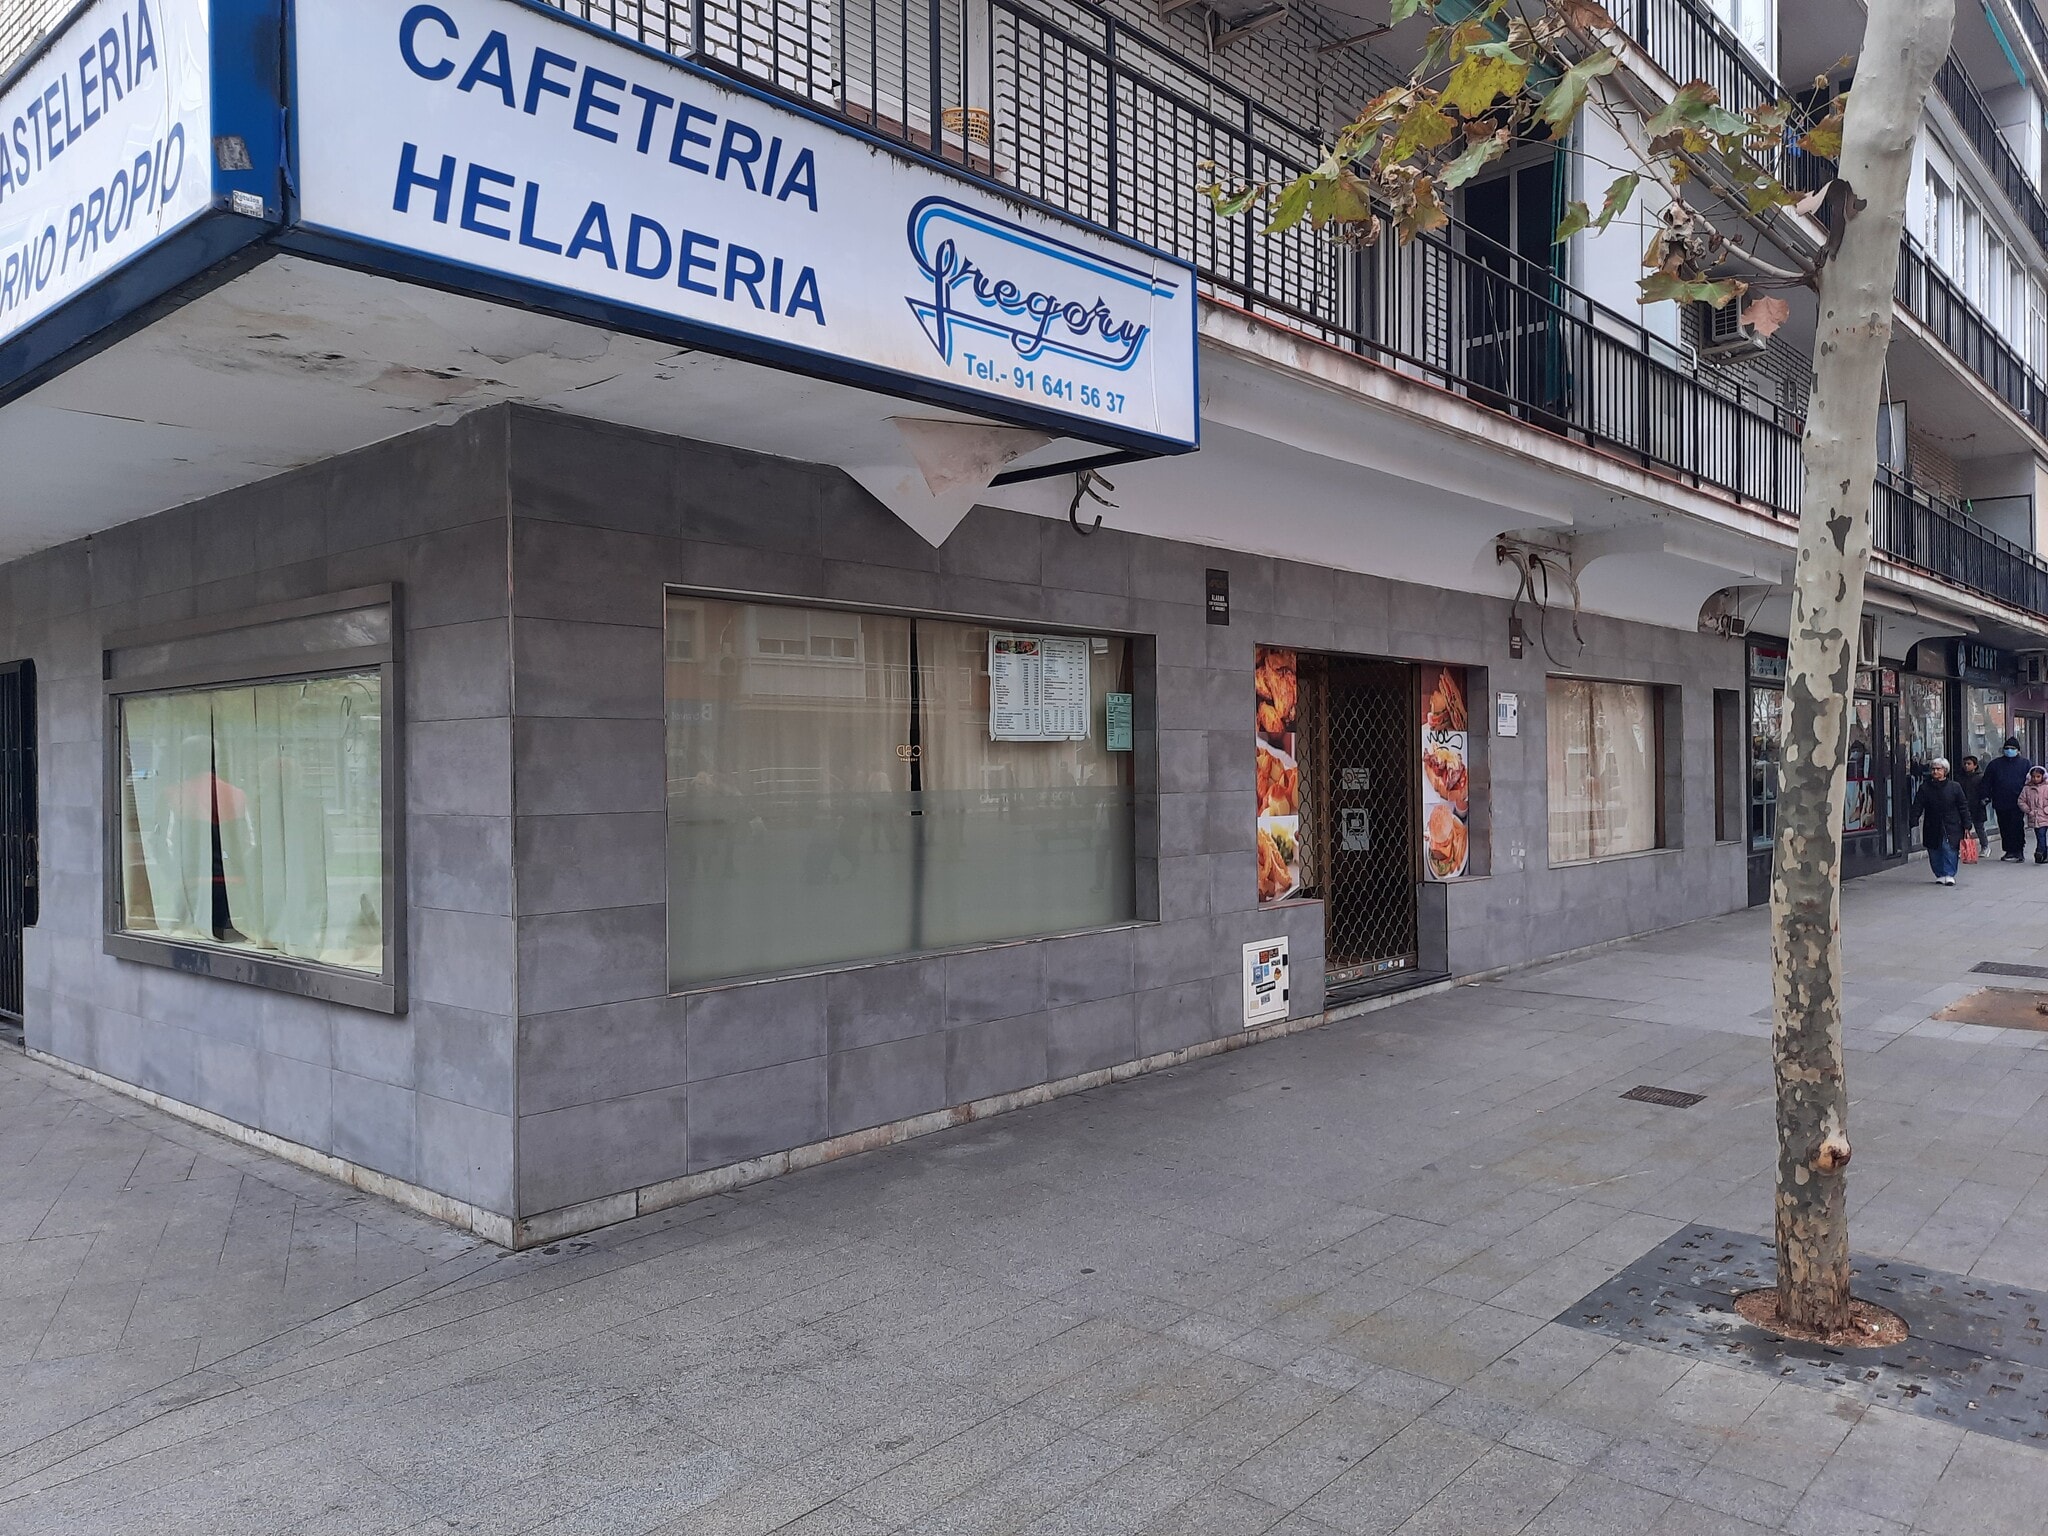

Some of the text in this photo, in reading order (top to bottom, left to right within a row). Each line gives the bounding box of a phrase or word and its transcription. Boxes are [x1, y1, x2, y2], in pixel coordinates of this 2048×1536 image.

[399, 4, 818, 212] CAFETERIA
[0, 121, 185, 319] RNO PROPIO
[392, 141, 826, 326] HELADERIA
[905, 196, 1151, 368] Gregory
[963, 352, 1125, 414] Tel.- 91 641 56 37
